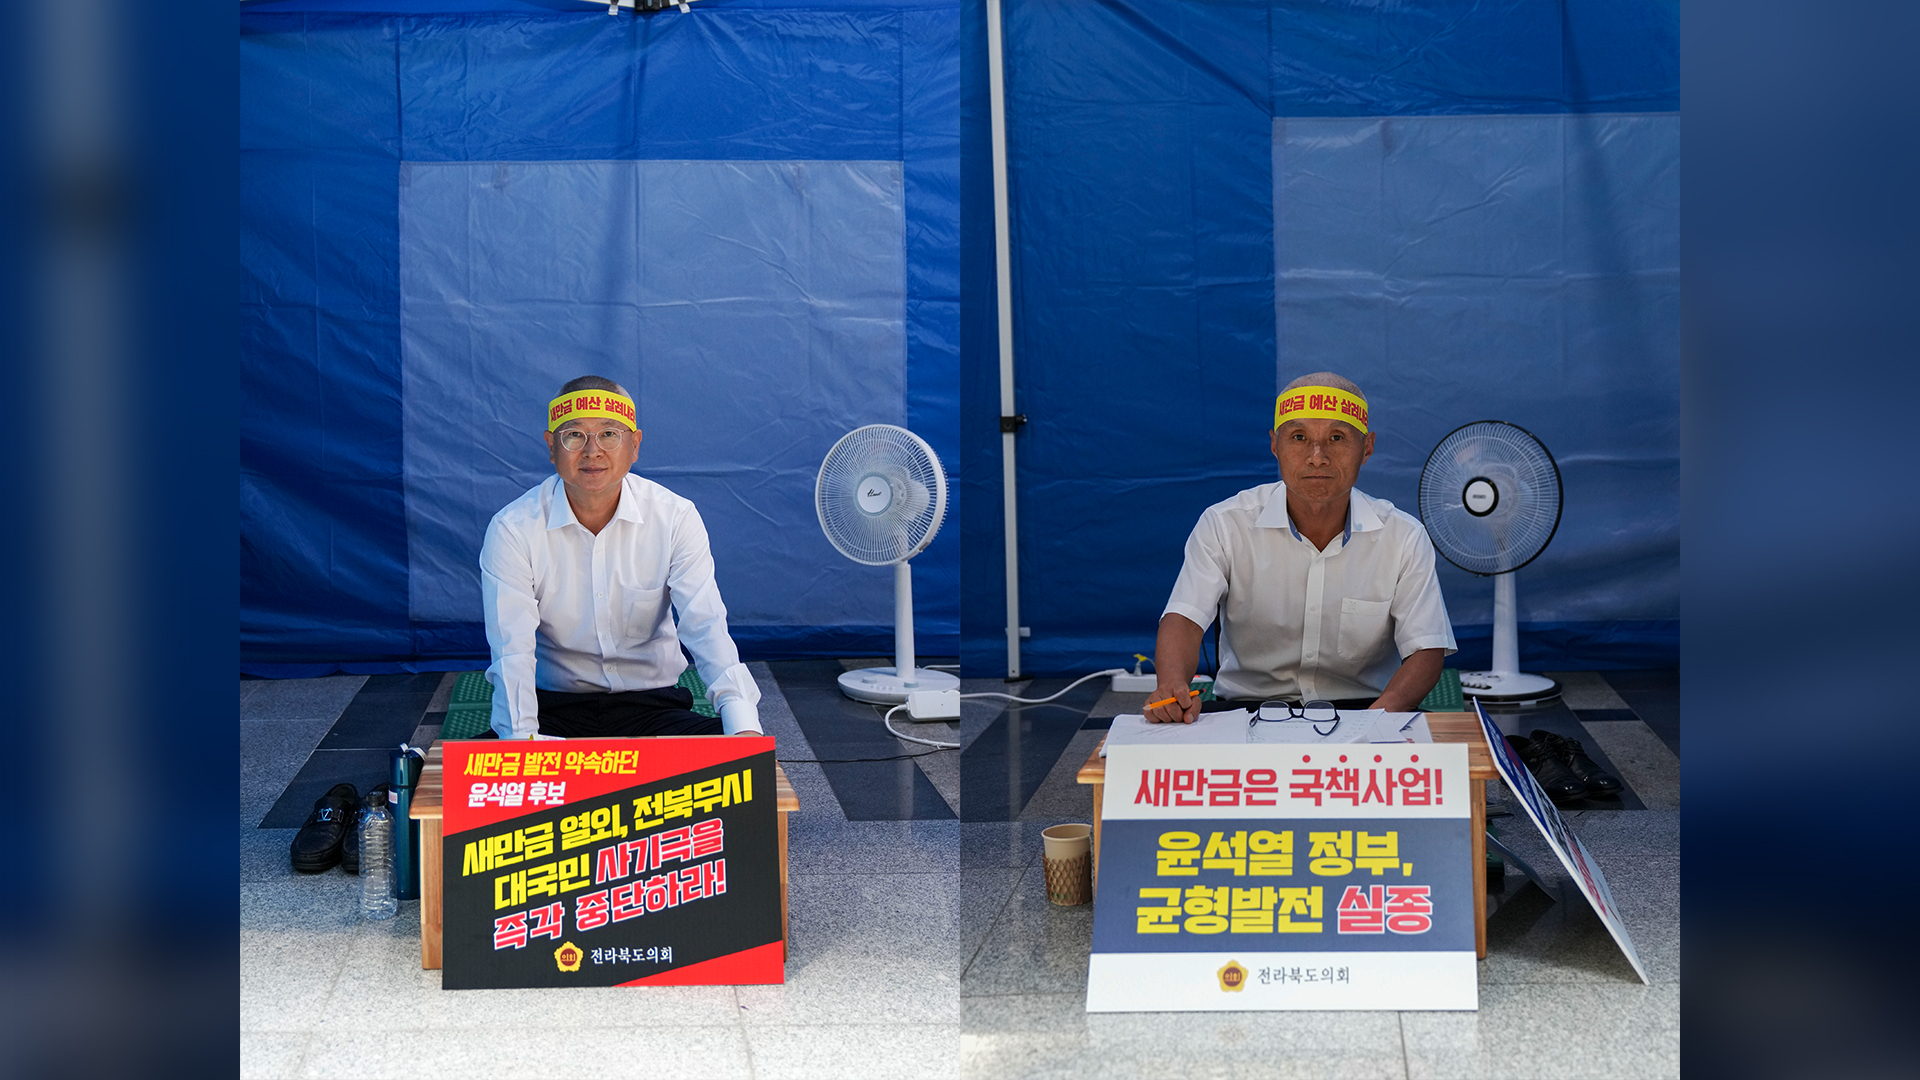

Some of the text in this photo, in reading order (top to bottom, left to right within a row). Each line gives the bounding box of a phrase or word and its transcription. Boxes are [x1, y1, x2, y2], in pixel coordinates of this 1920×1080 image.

[550, 399, 573, 422] 새만금
[576, 396, 602, 411] 예산
[1309, 394, 1338, 412] 예산
[463, 750, 639, 777] 새만금 발전 약속하던
[468, 781, 566, 807] 윤석열 후보
[1133, 767, 1443, 808] 새만금은 국책사업!
[462, 768, 753, 877] 새만금 열외, 전북무시
[494, 818, 724, 910] 대국민 사기극을
[1156, 830, 1413, 877] 윤석열 정부,
[493, 858, 727, 950] 즉각 중단하라!
[1136, 884, 1433, 935] 균형발전 실종
[590, 946, 673, 965] 전라북도의회
[1257, 965, 1350, 985] 전라북도의회
